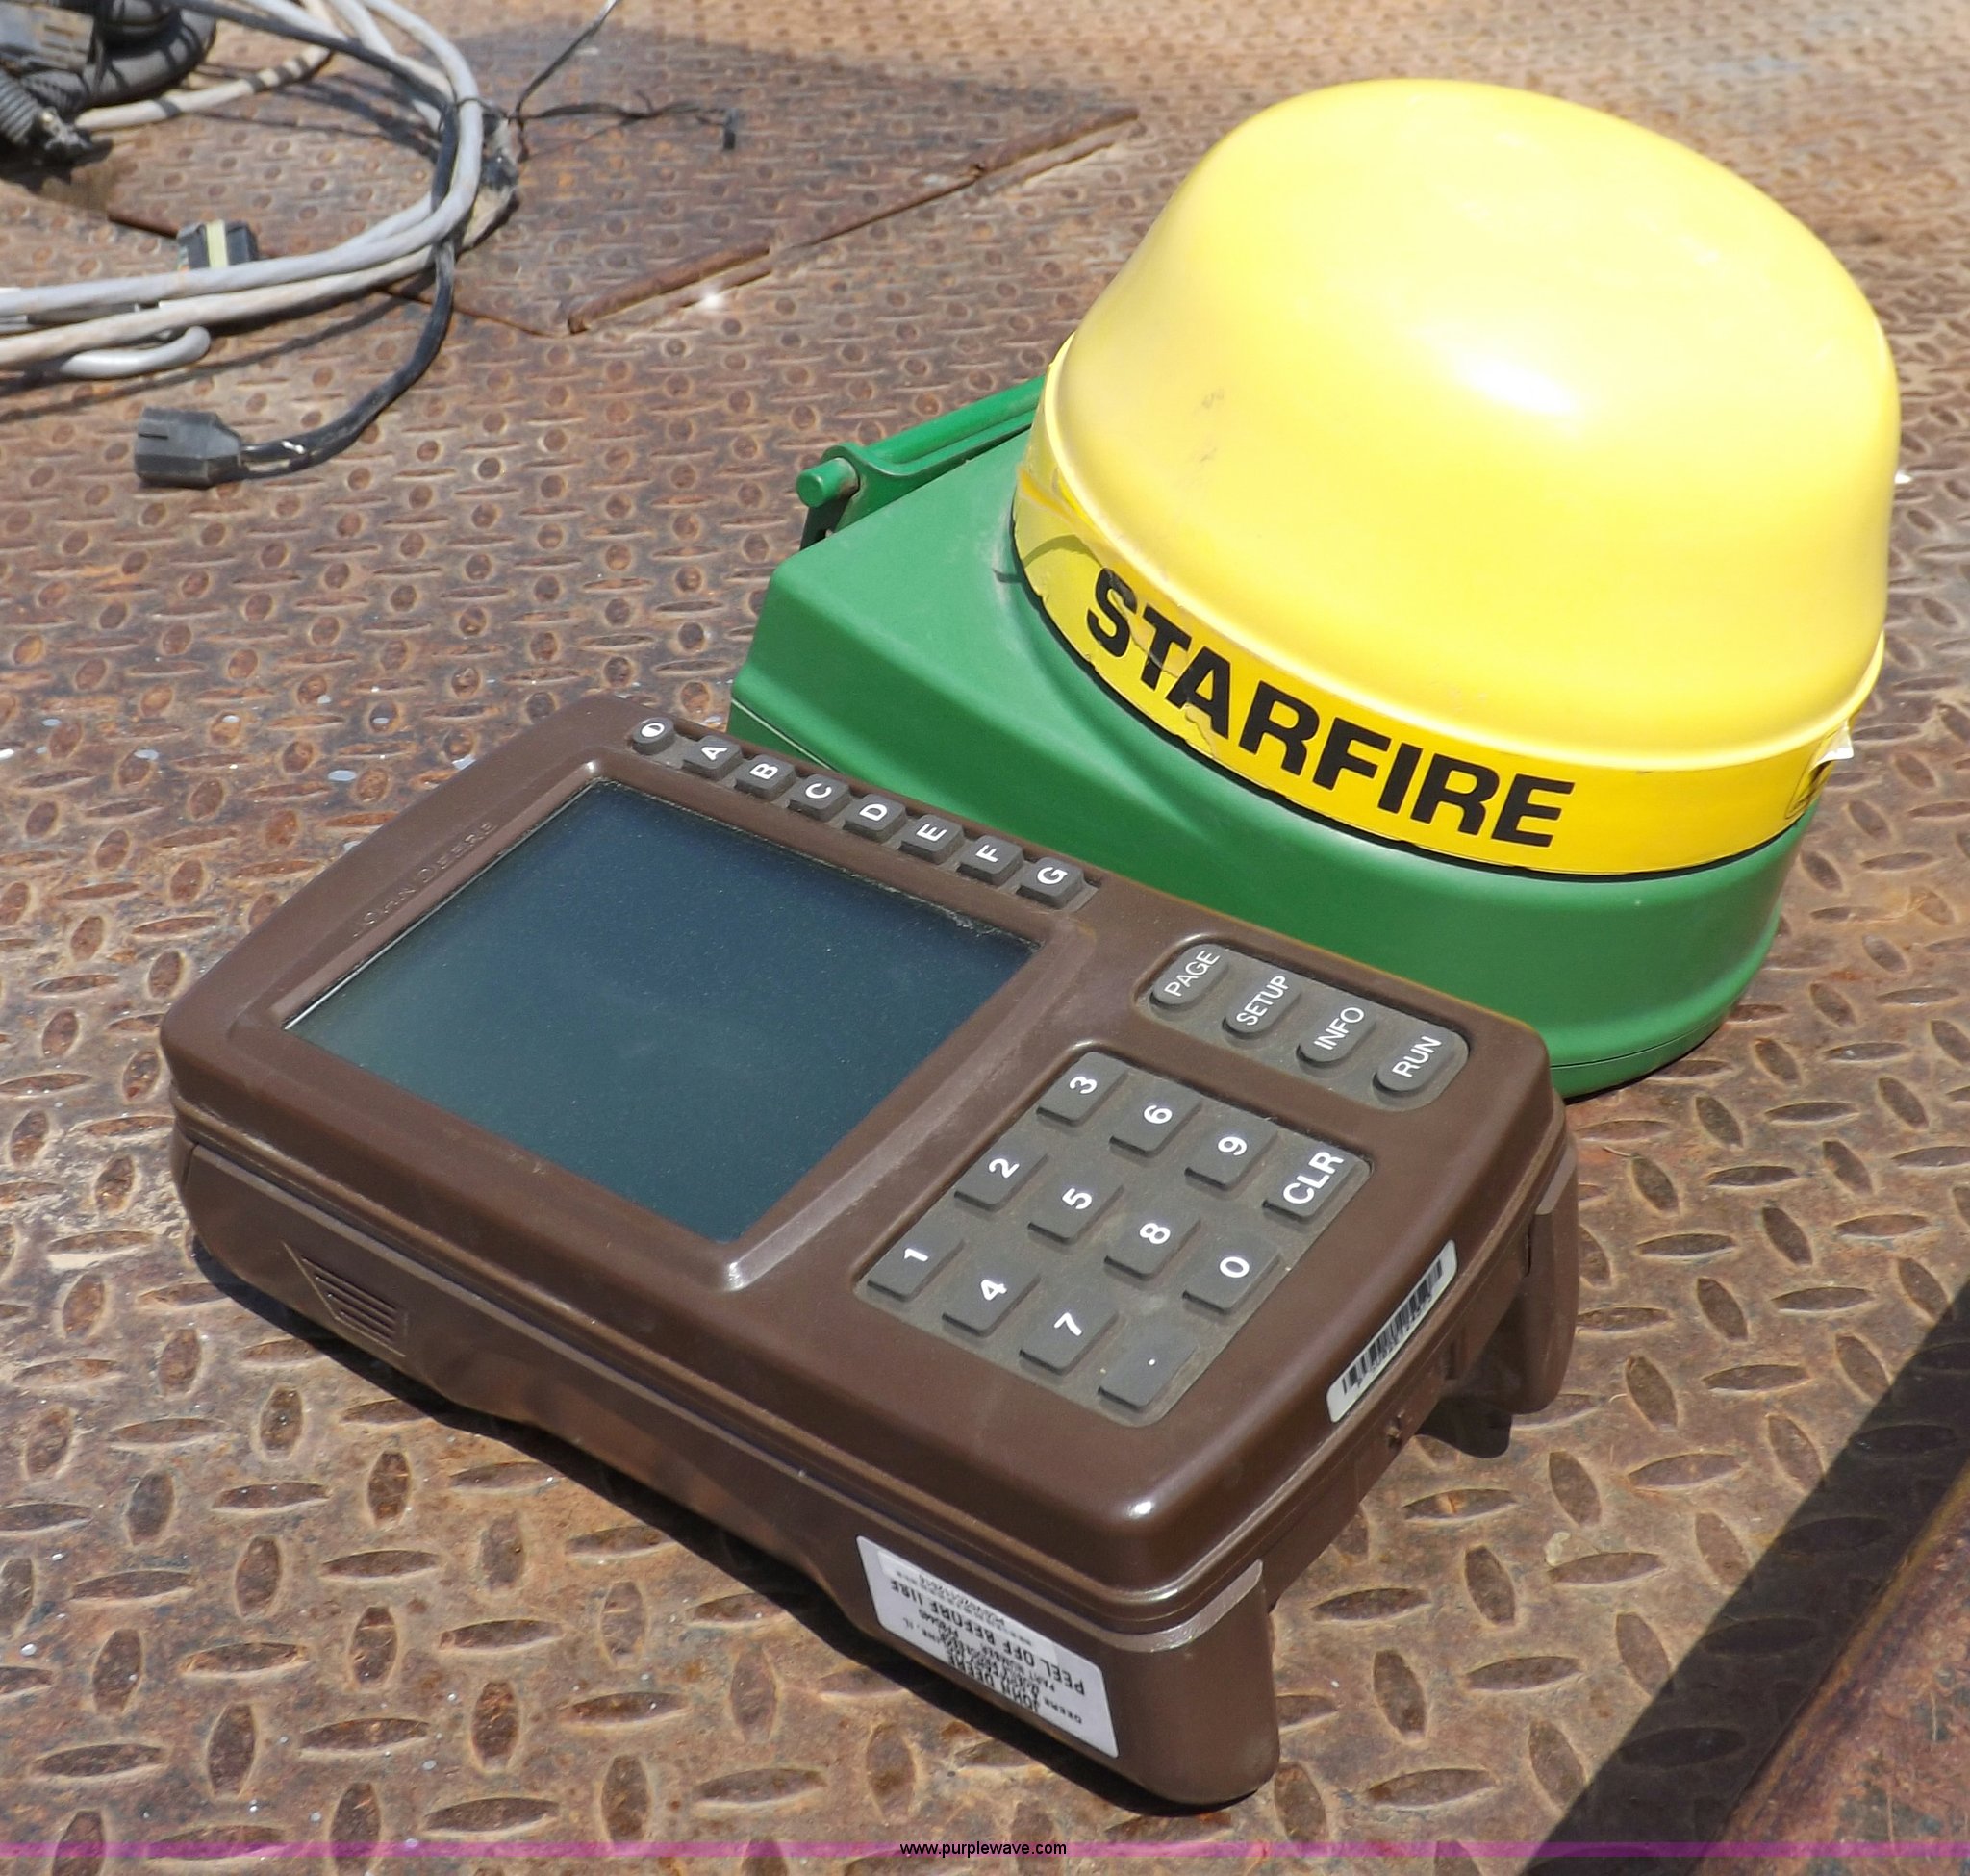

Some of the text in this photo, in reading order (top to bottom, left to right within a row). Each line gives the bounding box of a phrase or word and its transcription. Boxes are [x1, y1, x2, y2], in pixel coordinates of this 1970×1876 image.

[1085, 568, 1575, 848] STARFIRE
[700, 746, 728, 761] A
[749, 763, 779, 780] B
[805, 782, 833, 799] C
[859, 803, 888, 822] D
[916, 823, 947, 842] E
[974, 844, 998, 863] F
[1037, 866, 1068, 885] G
[1163, 950, 1221, 997] PAGE
[1235, 975, 1289, 1026] SETUP
[1313, 1006, 1365, 1051] INFO
[1391, 1035, 1442, 1078] RUN
[1069, 1075, 1098, 1095] 3
[1143, 1104, 1173, 1125] 6
[1217, 1134, 1248, 1156] 9
[988, 1157, 1020, 1179] 2
[1282, 1151, 1345, 1204] CLR
[1061, 1187, 1093, 1210] 5
[1139, 1221, 1172, 1245] 8
[903, 1247, 929, 1262] 1
[1219, 1255, 1250, 1279] 0
[980, 1279, 1008, 1301] 4
[1053, 1311, 1083, 1337] 7
[1001, 1638, 1035, 1666] OFF
[1041, 1658, 1085, 1696] PEEL
